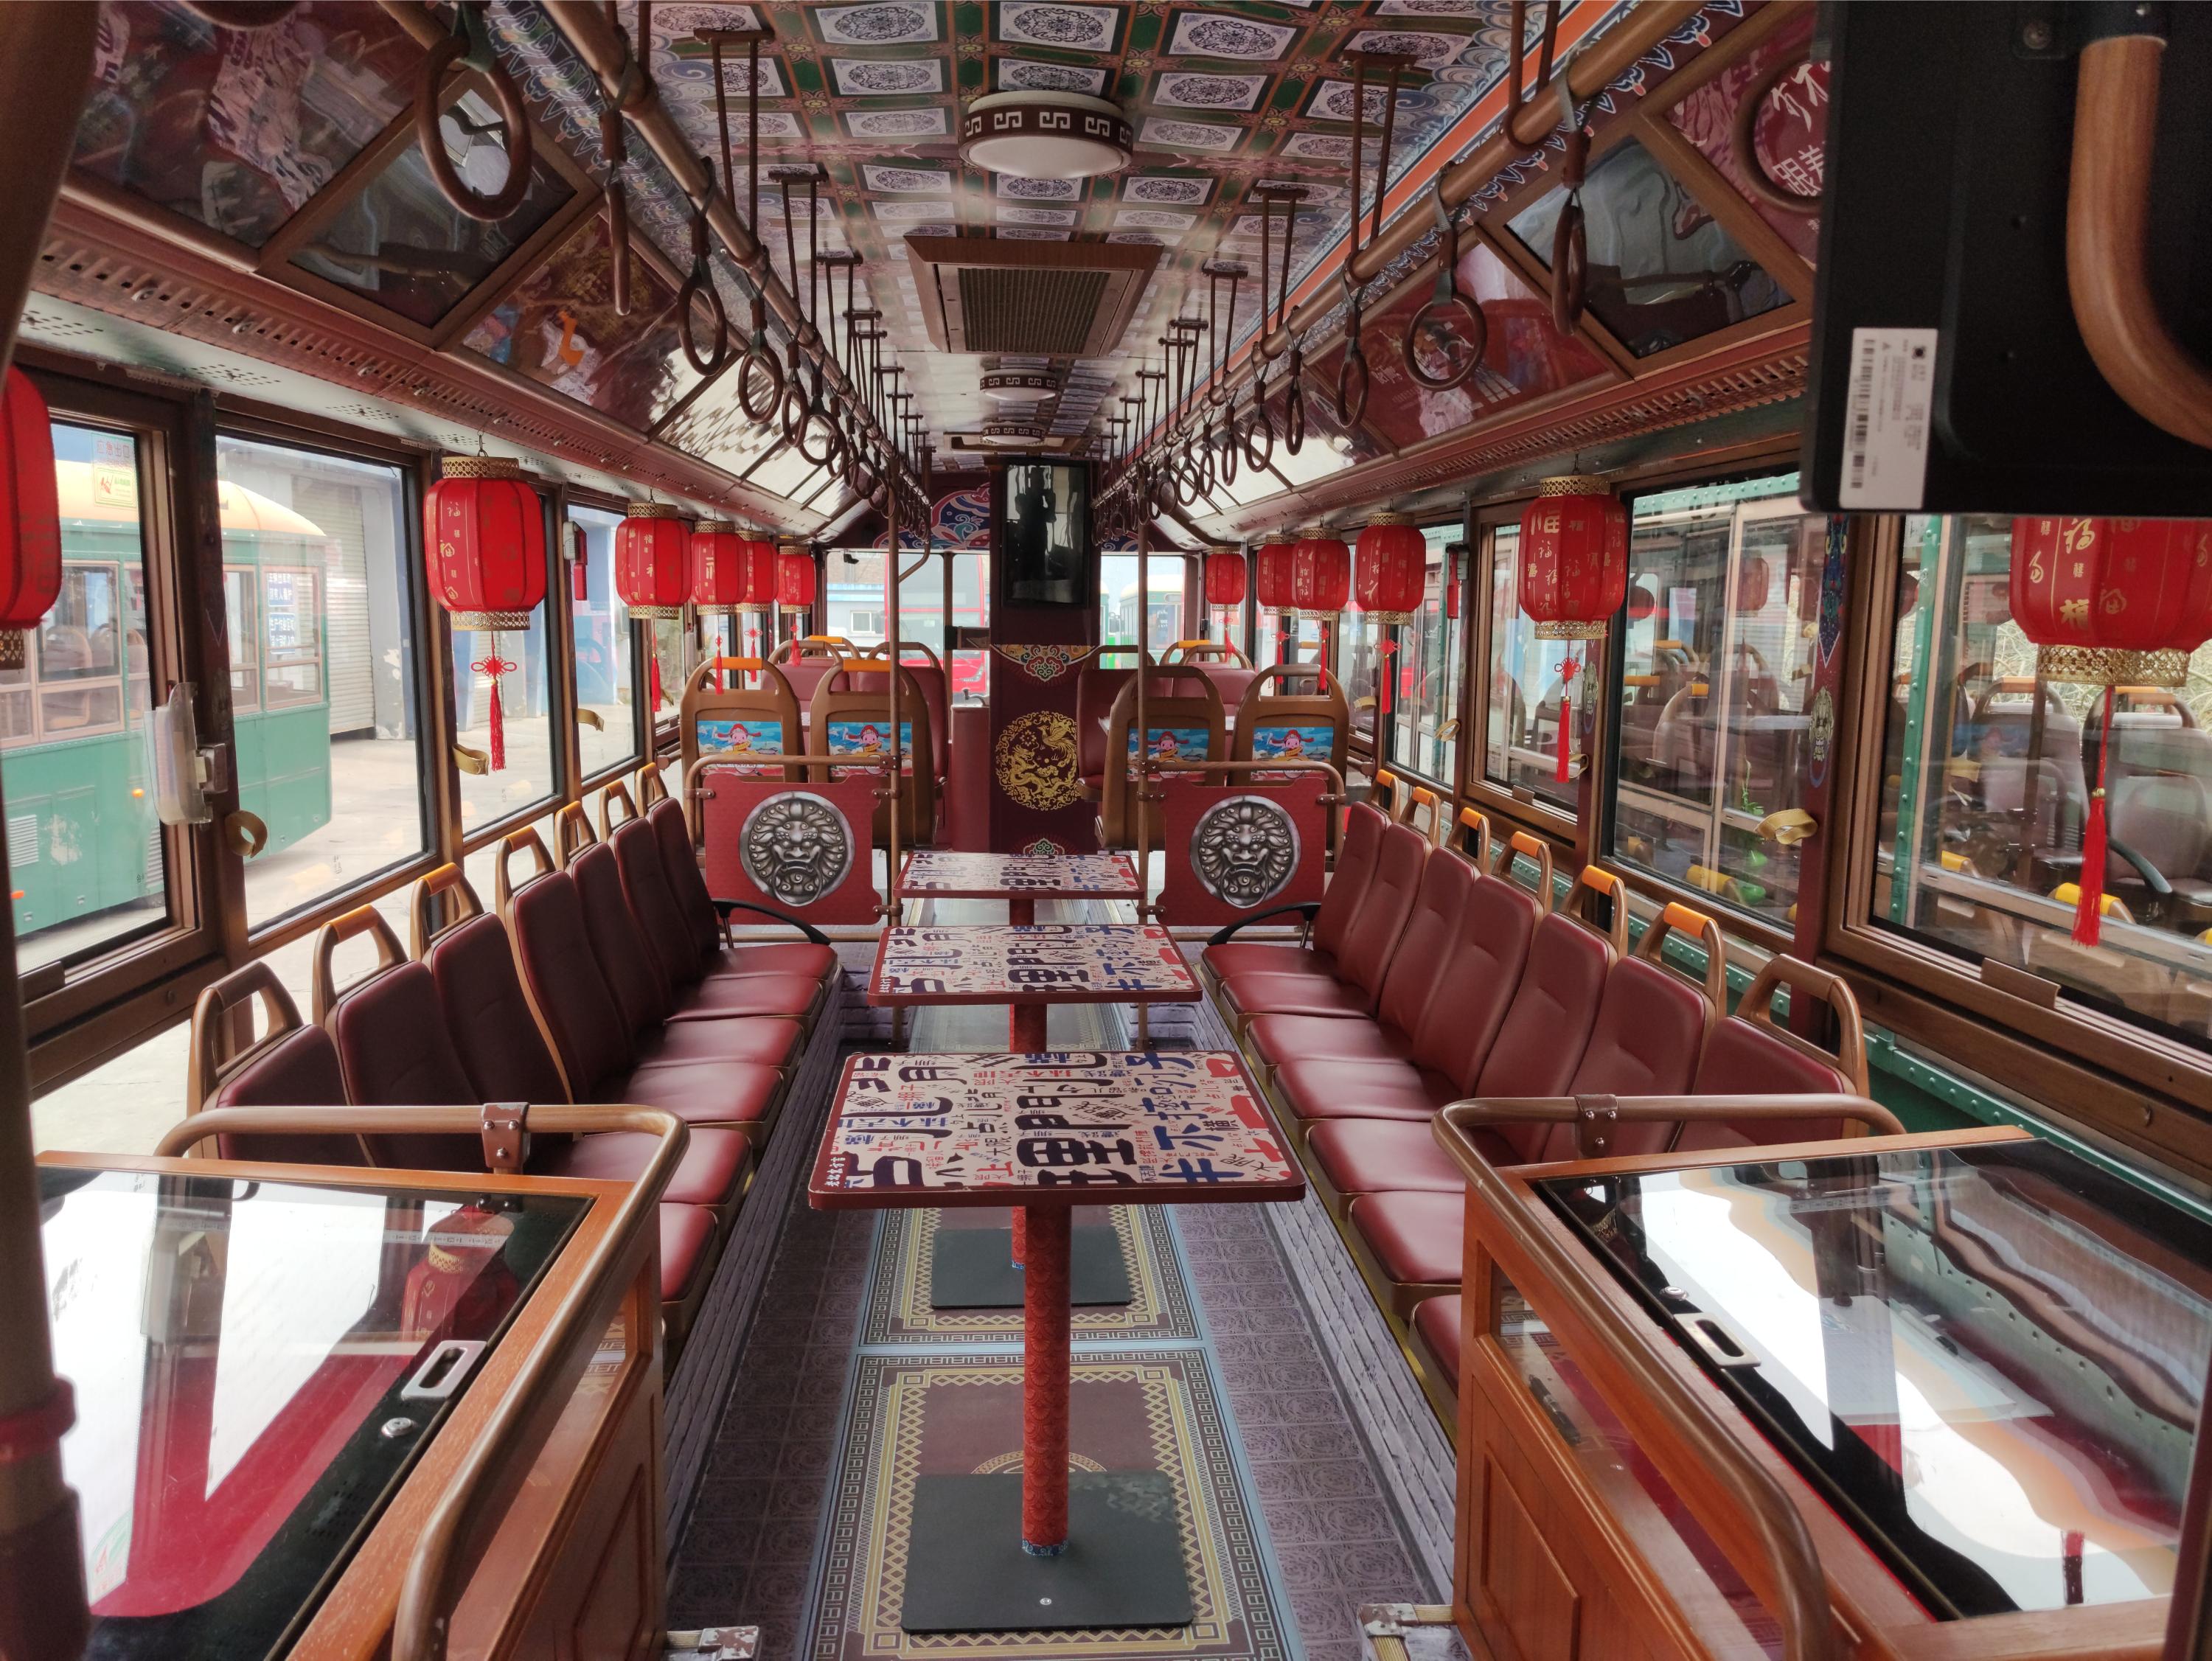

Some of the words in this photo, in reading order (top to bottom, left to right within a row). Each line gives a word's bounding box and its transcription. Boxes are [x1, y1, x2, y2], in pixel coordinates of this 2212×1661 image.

[97, 440, 130, 458] 应急出口
[1201, 1119, 1242, 1131] 横
[984, 1136, 1012, 1156] 大限
[823, 1156, 846, 1186] 老北京方言
